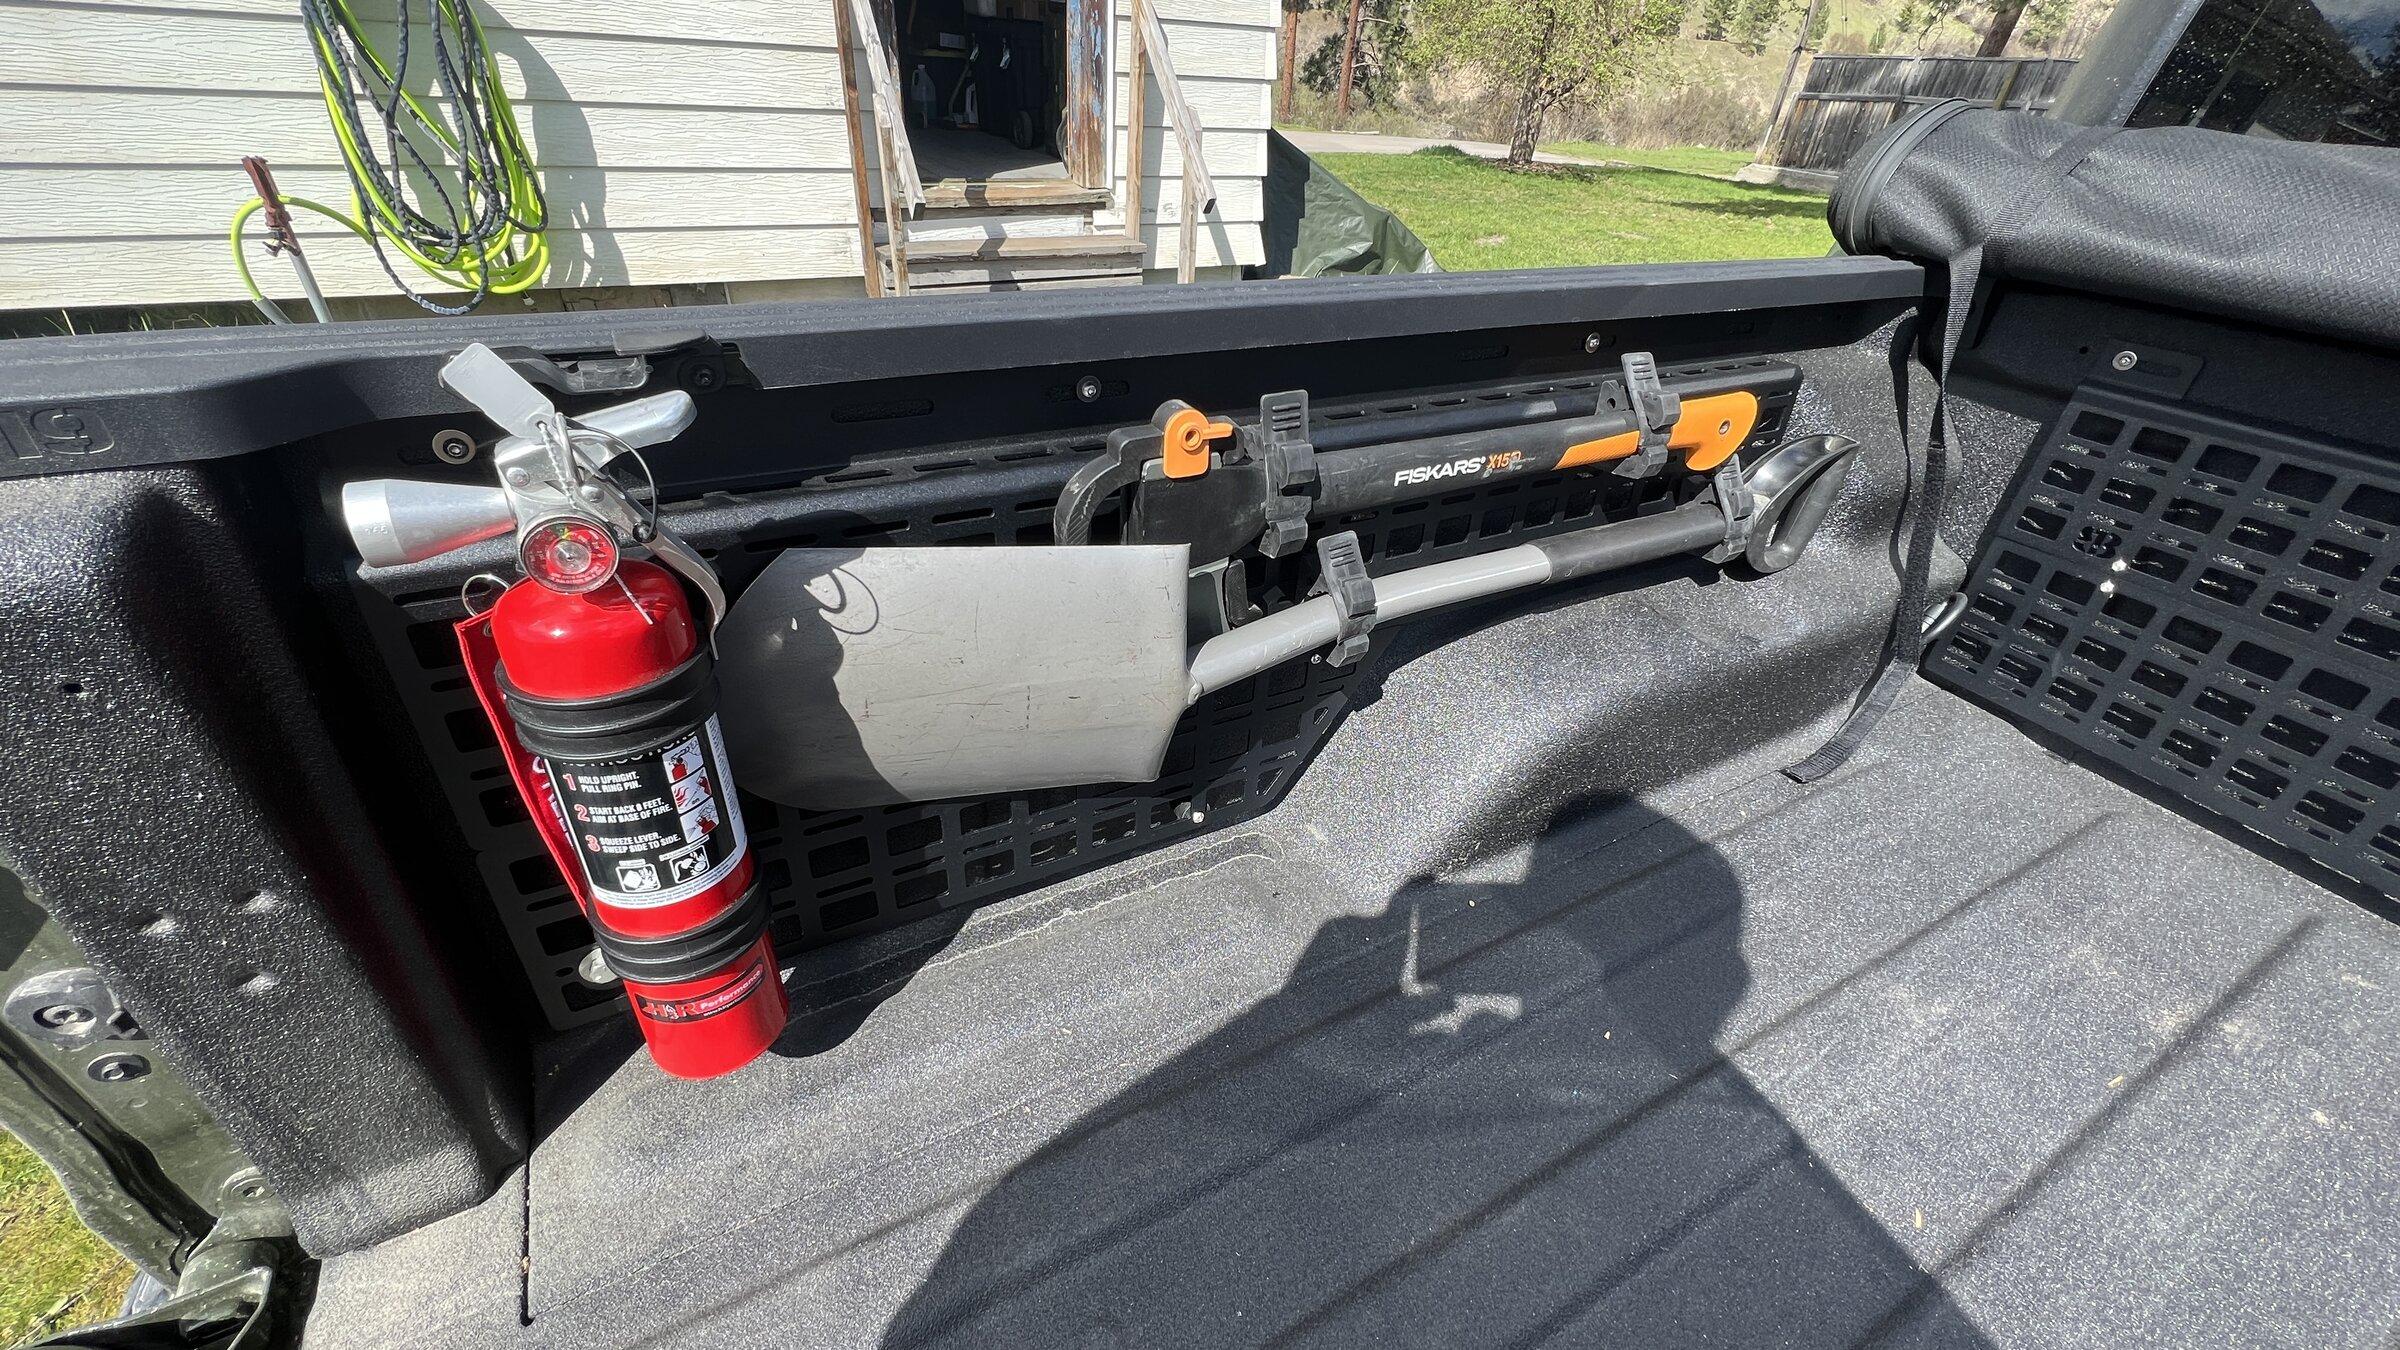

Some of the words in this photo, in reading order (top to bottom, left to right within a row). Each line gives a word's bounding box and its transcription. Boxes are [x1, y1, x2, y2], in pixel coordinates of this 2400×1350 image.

[1394, 457, 1482, 487] FISKARS
[563, 773, 576, 791] 1
[578, 775, 600, 784] HOLD
[600, 771, 640, 784] UPRIGHT.
[581, 784, 602, 793] PULL
[602, 783, 623, 793] RING
[624, 780, 642, 791] PIN.
[574, 804, 590, 822] 2
[588, 806, 612, 815] START
[613, 805, 636, 815] BACK
[642, 797, 665, 810] FEET.
[592, 815, 607, 823] AIM
[607, 815, 618, 823] AT
[618, 813, 640, 823] BASE
[640, 810, 652, 820] OF
[652, 803, 673, 817] FIRE.
[585, 834, 600, 852] 3
[599, 836, 633, 846] SQUEEZE
[634, 832, 662, 844] LEVER.
[602, 845, 628, 854] SWEEP
[629, 843, 648, 853] SIDE
[648, 841, 660, 850] TO
[660, 834, 682, 847] SIDE.
[700, 970, 761, 1009] Performance
